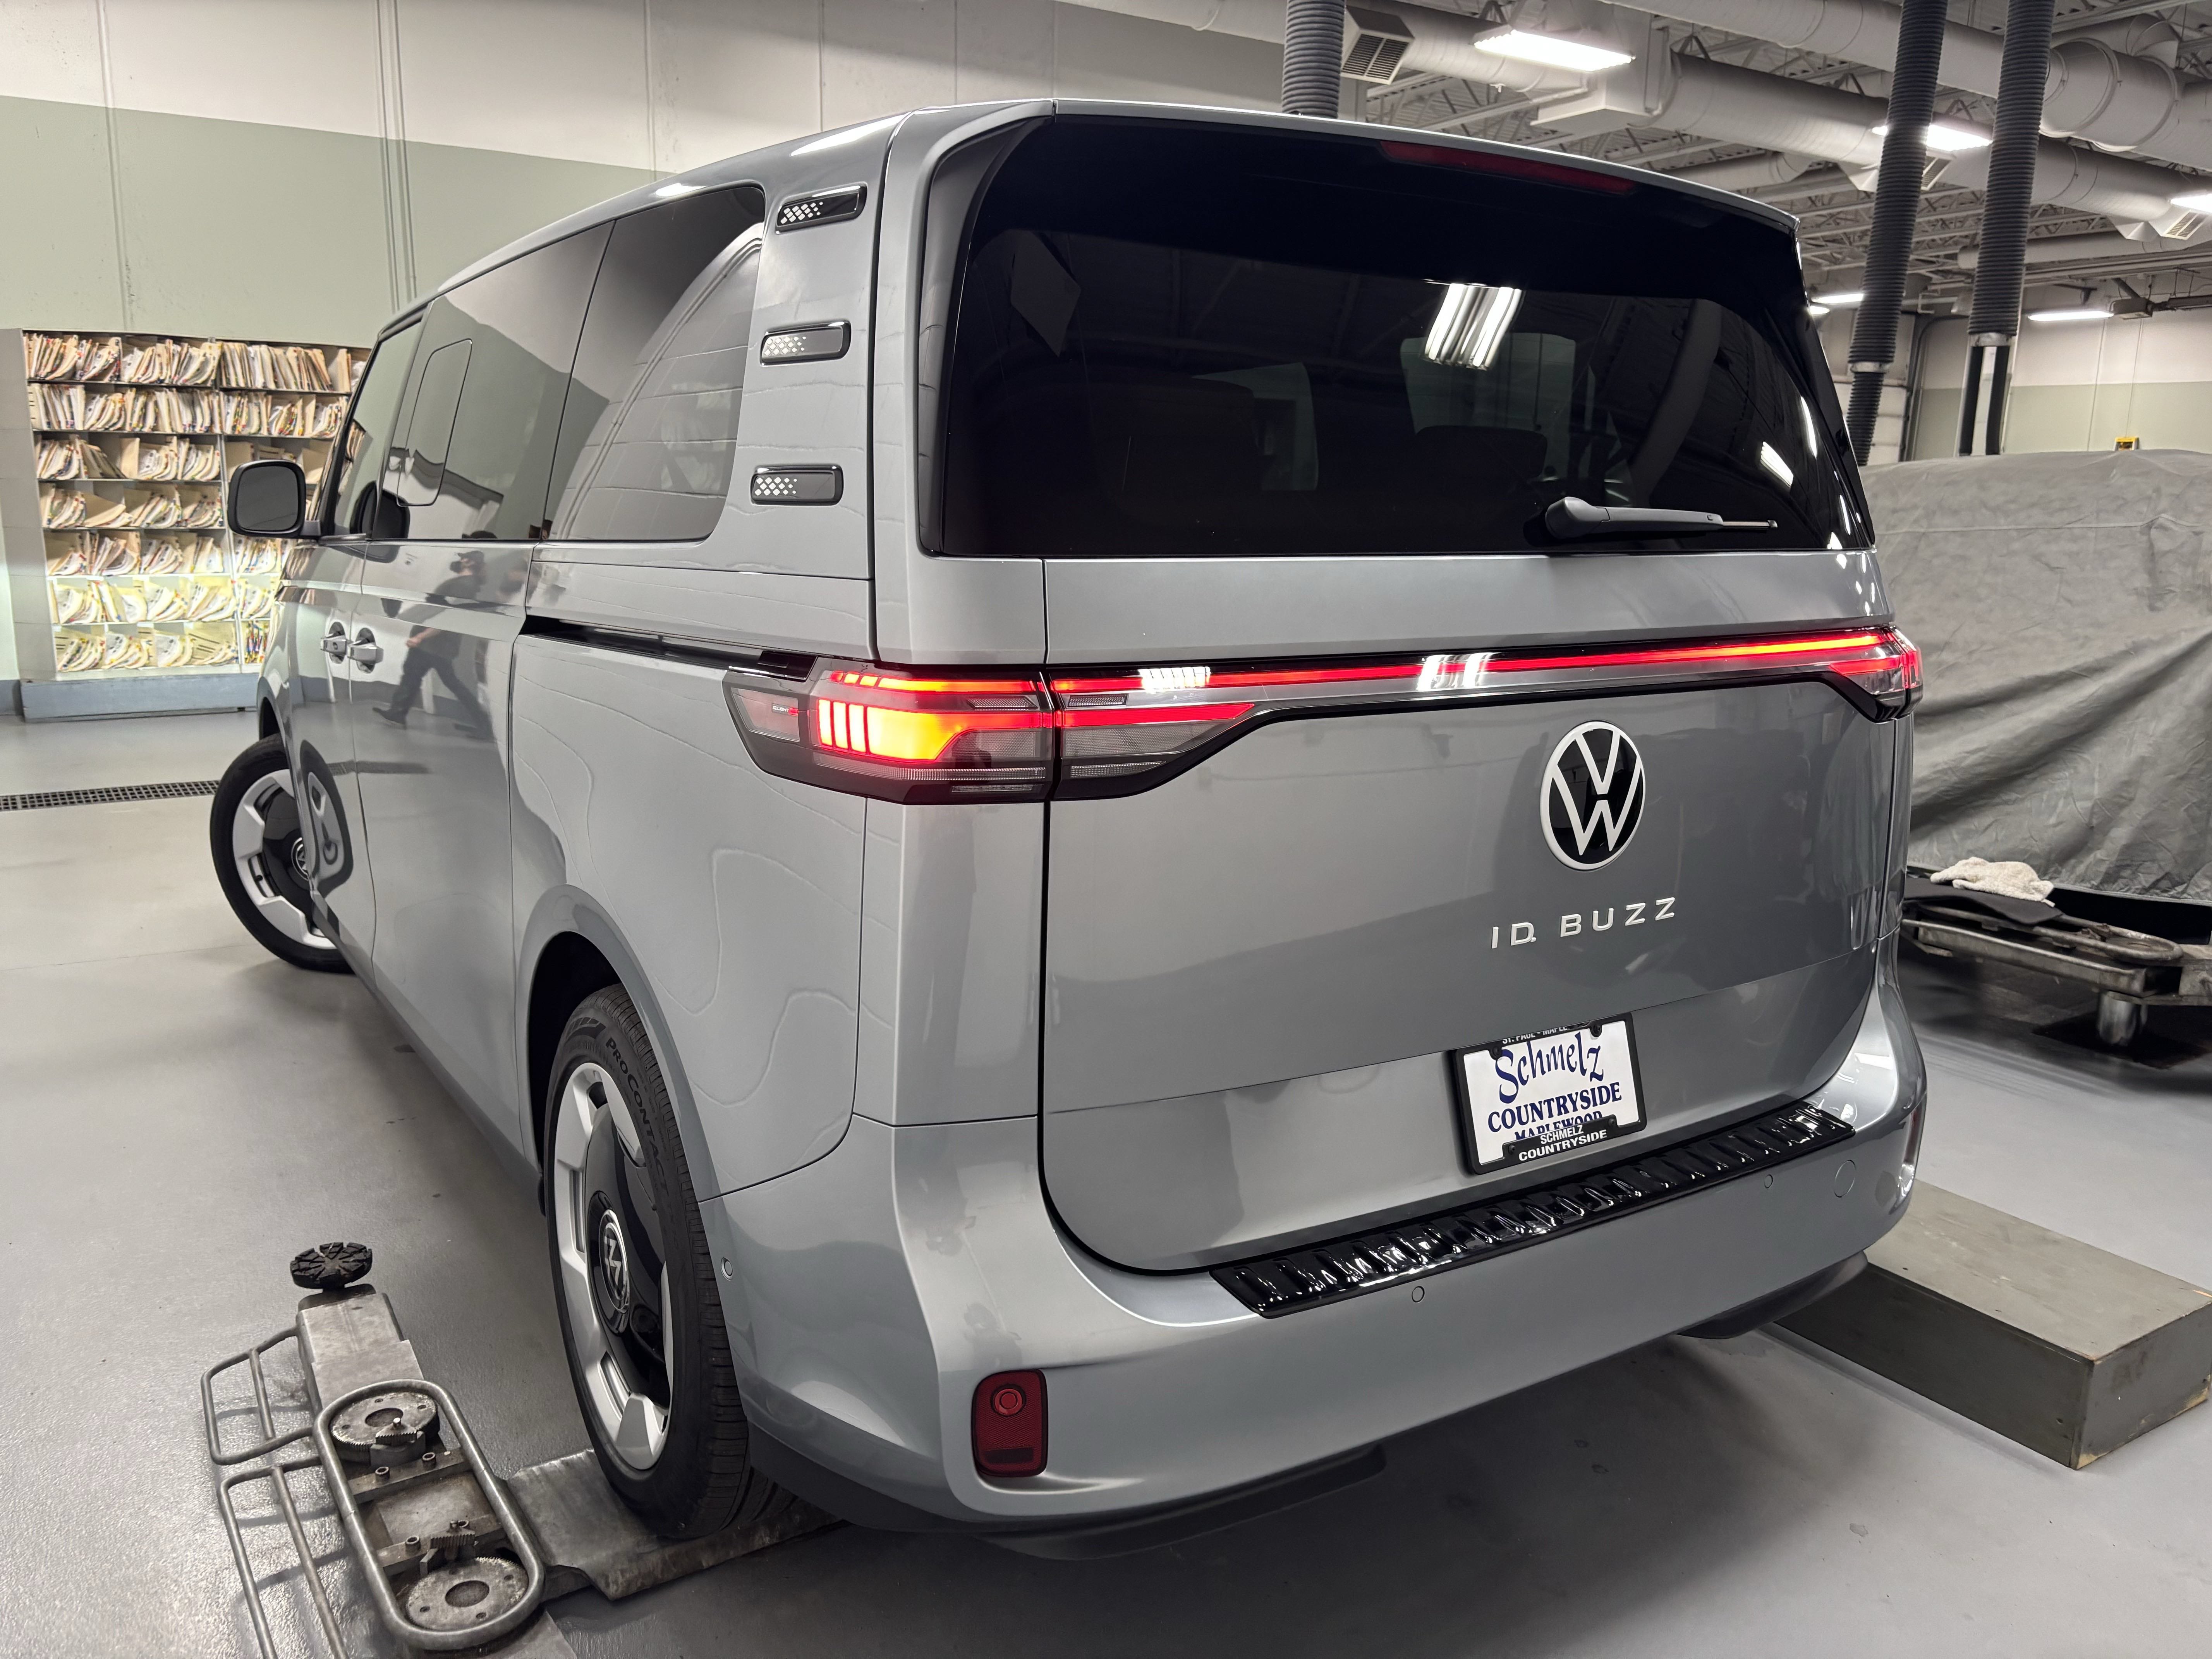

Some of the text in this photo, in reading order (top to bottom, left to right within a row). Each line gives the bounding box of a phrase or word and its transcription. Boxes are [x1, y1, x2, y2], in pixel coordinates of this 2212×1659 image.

[1560, 897, 1675, 937] BUZZ
[1495, 1032, 1604, 1104] Schmelz
[1488, 1082, 1622, 1133] COUNTRYSIDE
[1518, 1129, 1607, 1161] COUNTRYSIDE
[1540, 1125, 1584, 1144] SCHMELZ
